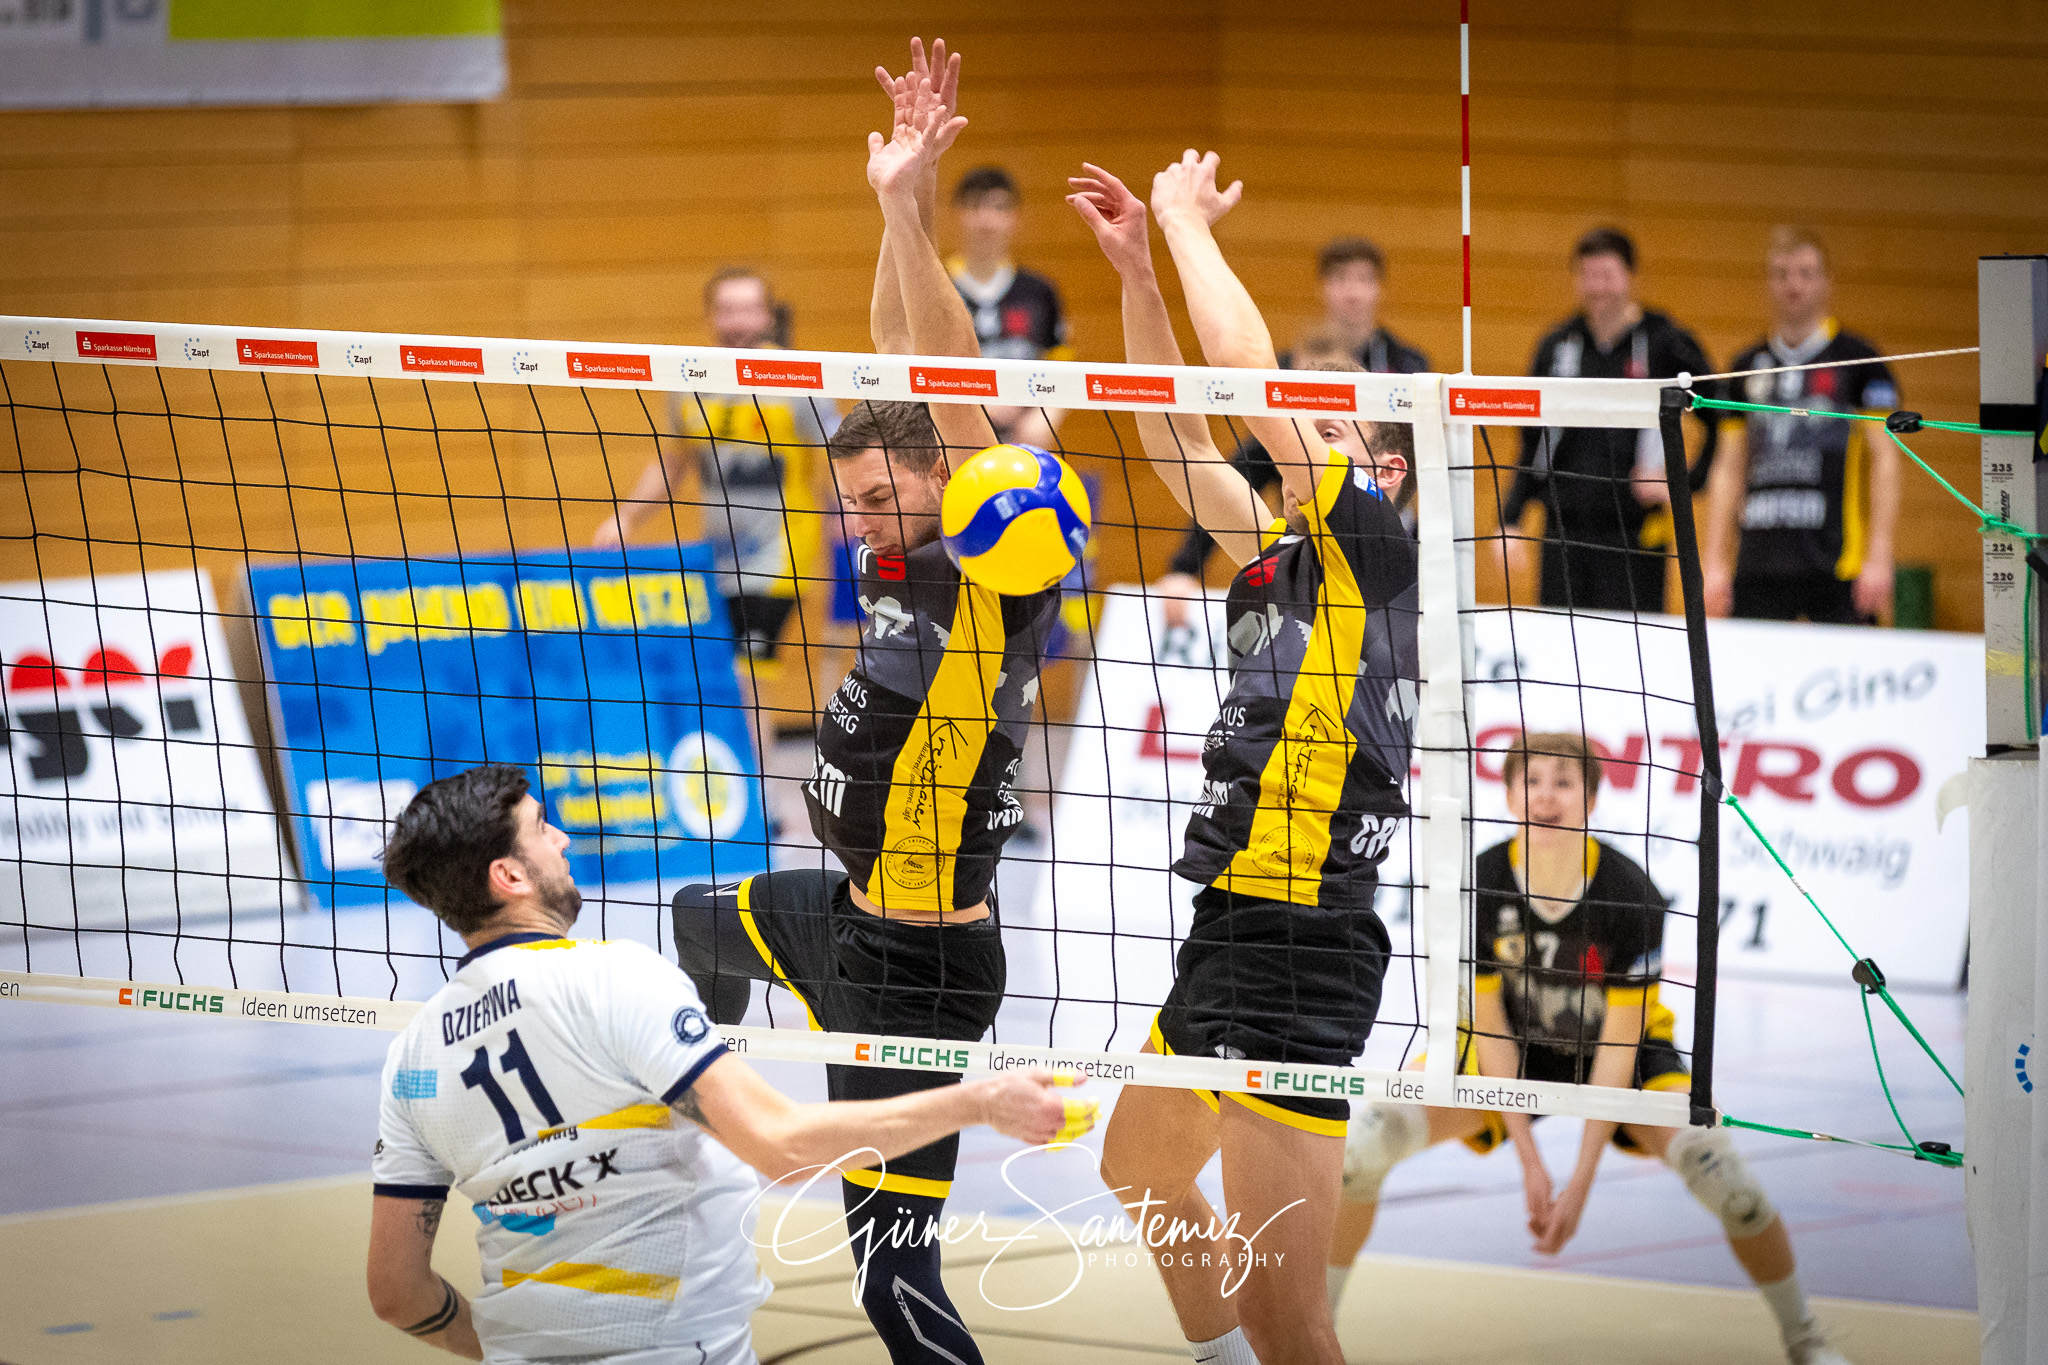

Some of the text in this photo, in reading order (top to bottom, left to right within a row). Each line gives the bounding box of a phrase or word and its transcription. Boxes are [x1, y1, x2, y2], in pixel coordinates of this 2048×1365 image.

[32, 341, 50, 352] Zapf
[94, 344, 151, 355] Sparkasse Nürnberg
[191, 349, 210, 360] Zapf
[255, 351, 313, 362] Sparkasse Nürnberg
[354, 356, 372, 367] Zapf
[418, 358, 478, 369] Sparkasse Nürnberg
[520, 363, 538, 373] Zapf
[585, 364, 646, 376] Sparkasse Nürnberg
[689, 370, 707, 380] Zapf
[755, 371, 817, 384] Sparkasse Nürnberg
[861, 377, 880, 387] Zapf
[928, 379, 992, 392] Sparkasse Nürnberg
[1036, 385, 1055, 395] Zapf
[1104, 386, 1170, 399] Sparkasse Nürnberg
[1215, 392, 1234, 402] Zapf
[1284, 394, 1350, 407] Sparkasse Nürnberg
[1397, 399, 1413, 409] Zap
[1468, 400, 1535, 412] Sparkasse Nürnberg
[1991, 463, 2013, 473] 235
[1992, 543, 2014, 552] 224
[1992, 572, 2014, 581] 220
[1796, 661, 1937, 721] Gino
[1534, 930, 1560, 969] 7
[143, 990, 224, 1013] FUCHS
[242, 996, 377, 1025] Ideen umsetzen
[881, 1045, 969, 1068] FUCHS
[989, 1051, 1037, 1071] Ideen
[460, 1028, 565, 1146] 11
[1274, 1072, 1365, 1096] FUCHS
[1386, 1078, 1538, 1109] Idee msetzen
